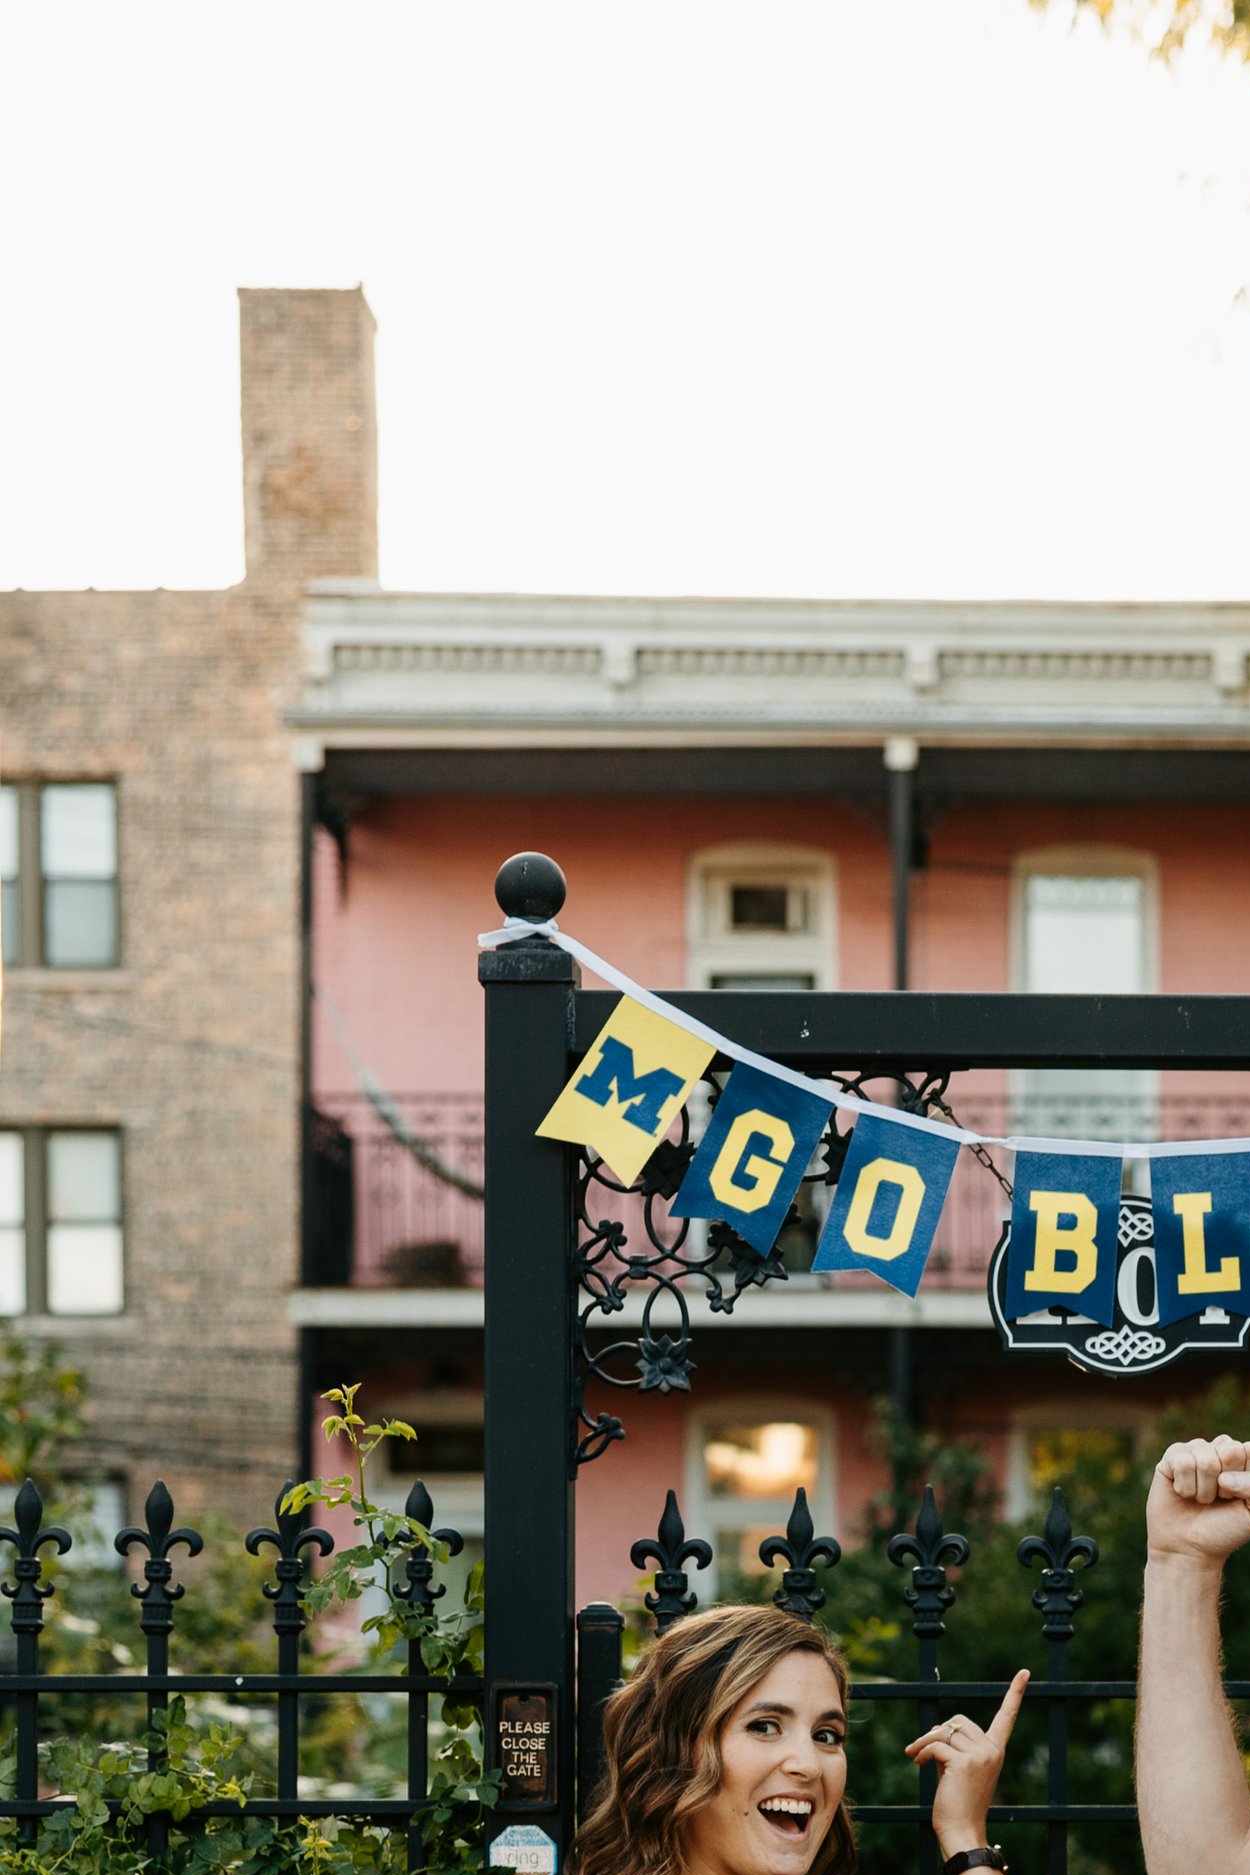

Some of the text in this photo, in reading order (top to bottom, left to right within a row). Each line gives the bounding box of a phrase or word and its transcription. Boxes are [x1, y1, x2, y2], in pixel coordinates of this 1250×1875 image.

[575, 1035, 687, 1137] M
[499, 1721, 551, 1735] PLEASE
[501, 1737, 547, 1750] CLOSE
[512, 1751, 537, 1764] THE
[506, 1764, 541, 1777] GATE
[507, 1851, 539, 1869] ring
